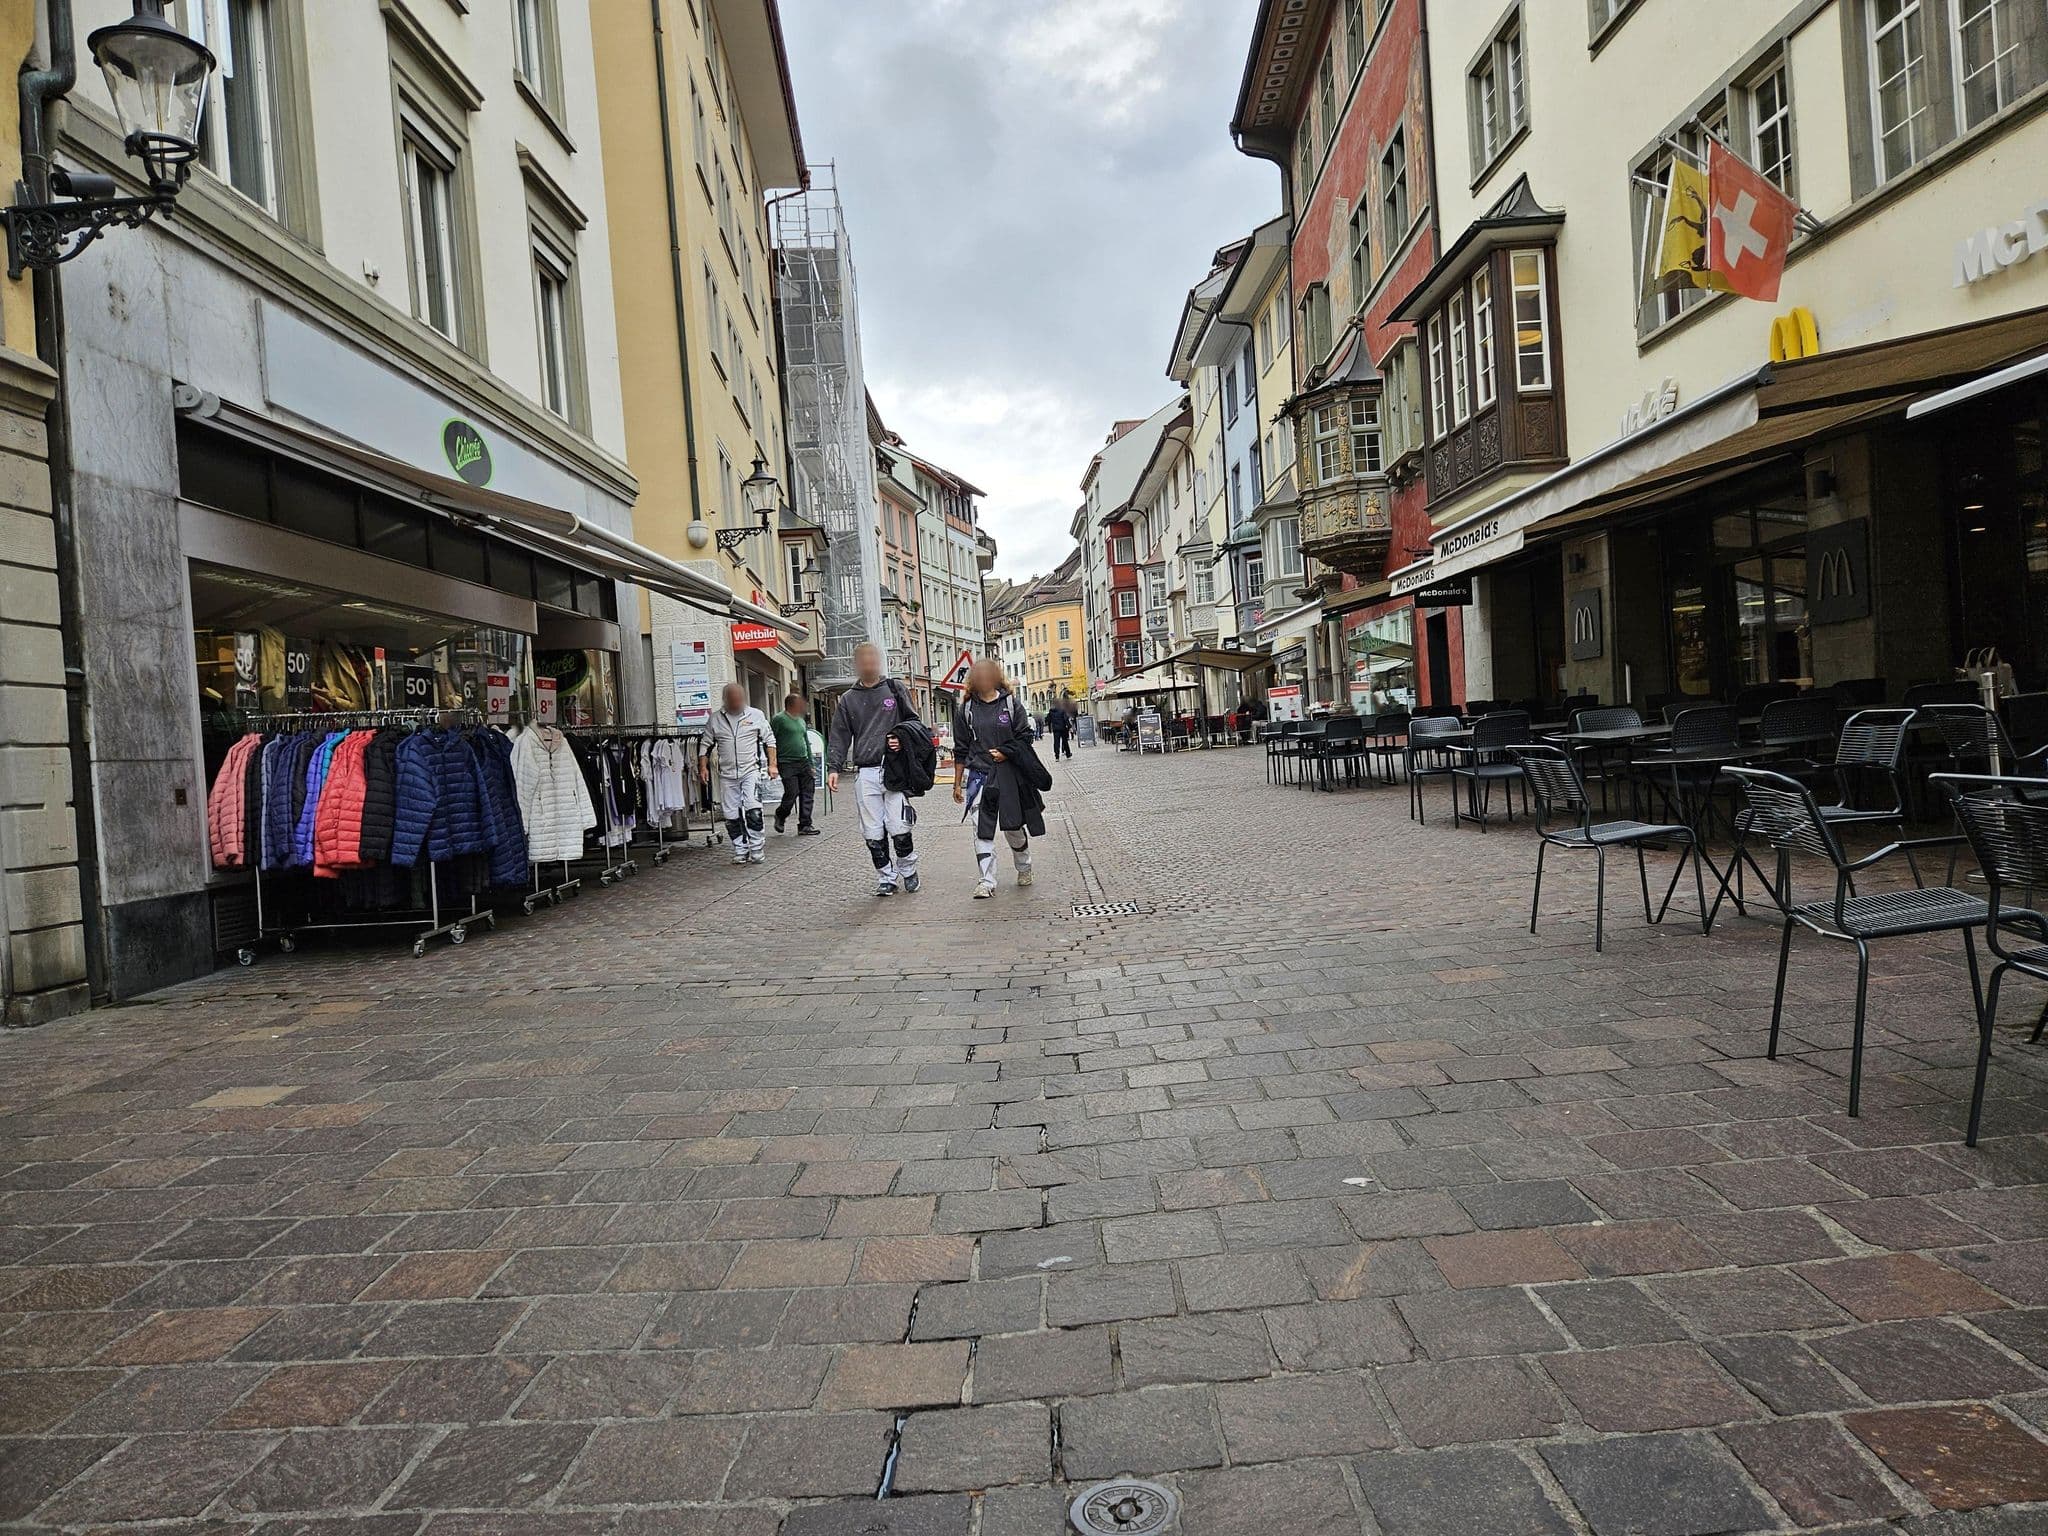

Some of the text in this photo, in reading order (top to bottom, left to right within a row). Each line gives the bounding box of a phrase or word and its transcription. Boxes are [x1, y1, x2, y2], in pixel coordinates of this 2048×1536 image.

[1440, 521, 1499, 558] McDonald's
[1396, 569, 1435, 593] McDonald's
[1419, 588, 1467, 597] McDonald's
[733, 629, 776, 641] Weltbild
